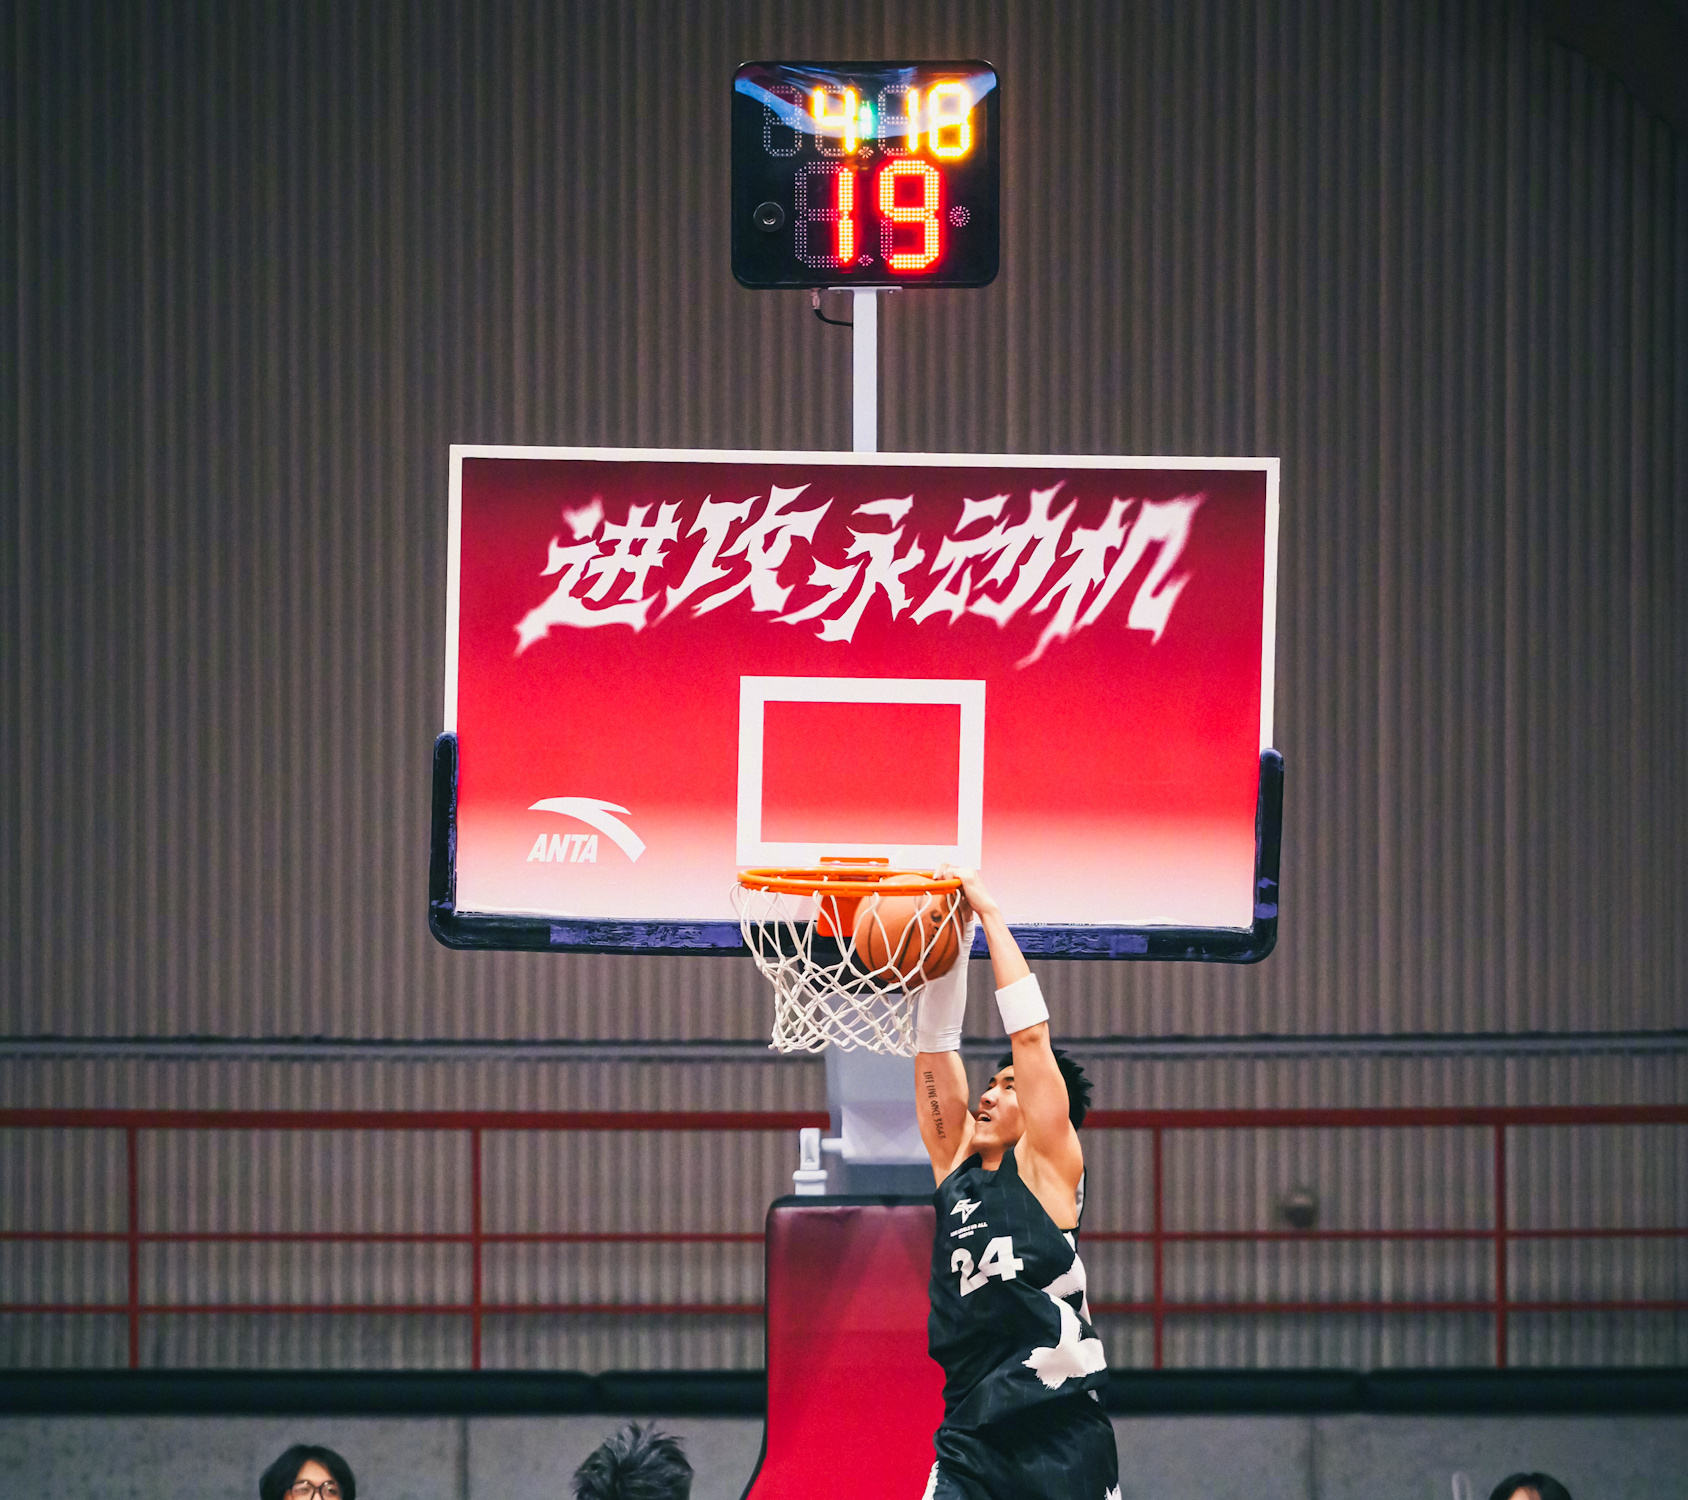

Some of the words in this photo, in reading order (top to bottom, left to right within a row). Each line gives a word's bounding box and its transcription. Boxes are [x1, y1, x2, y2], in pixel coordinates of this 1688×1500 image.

[837, 160, 941, 270] 19
[514, 481, 1202, 668] 进攻永动机
[526, 833, 598, 863] ANTA
[951, 1236, 1024, 1297] 24
